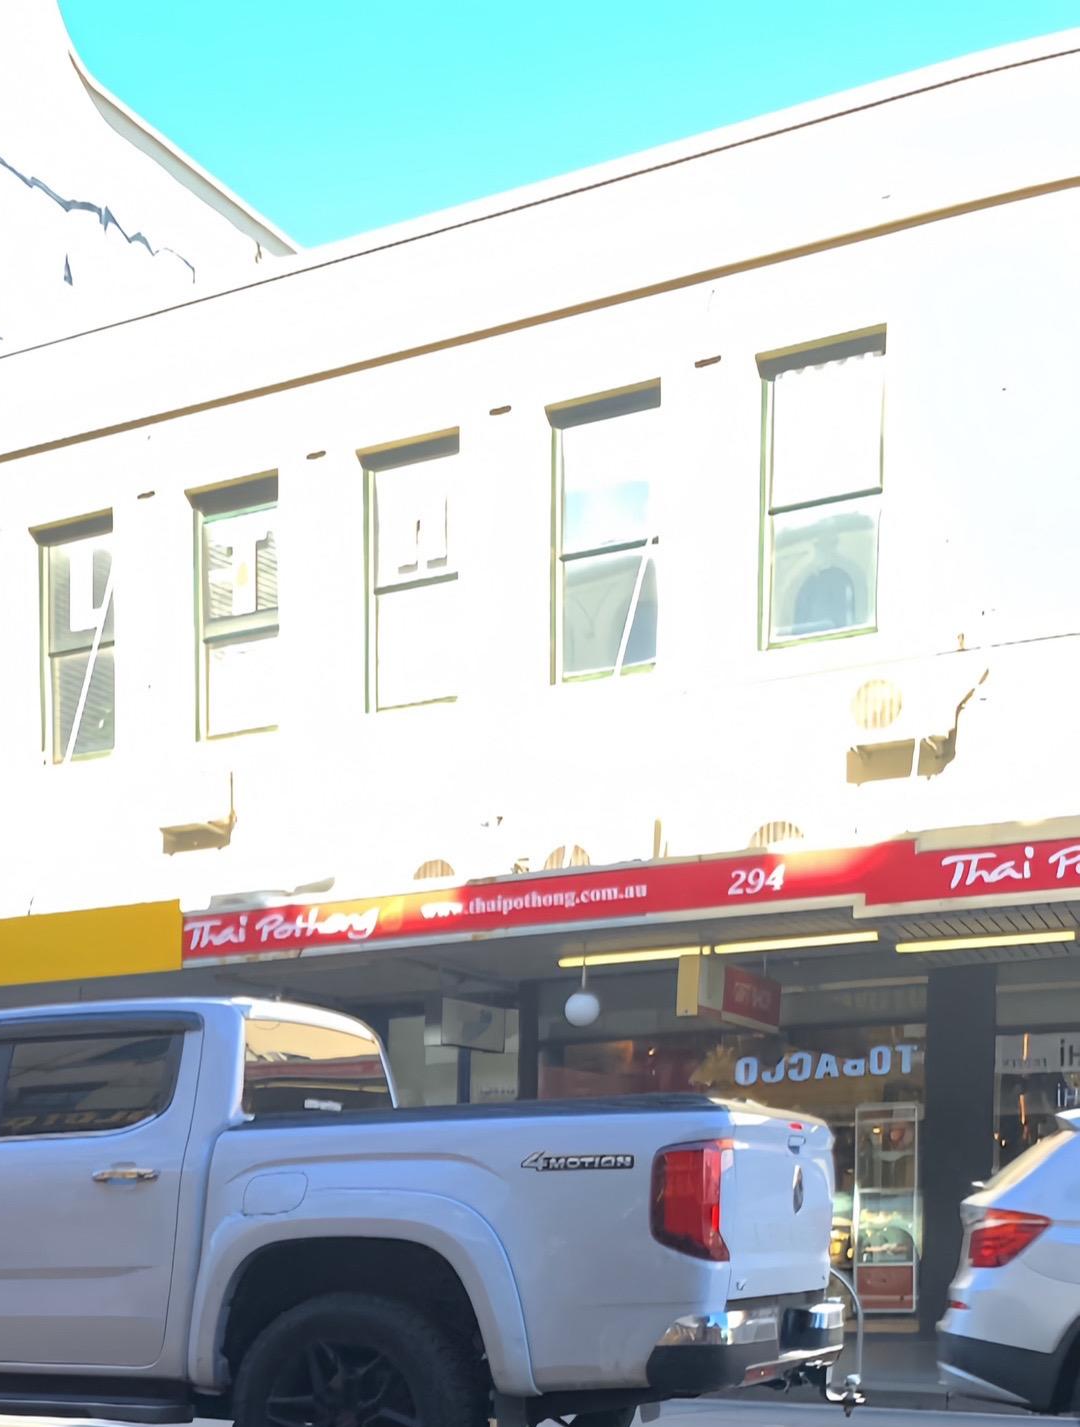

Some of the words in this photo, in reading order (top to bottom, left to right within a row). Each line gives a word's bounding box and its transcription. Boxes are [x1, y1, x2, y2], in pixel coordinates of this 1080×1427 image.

[728, 864, 786, 895] 294
[942, 846, 1034, 889] Thai
[420, 884, 647, 919] www.thaipothong.com.au
[184, 915, 248, 949] Thai
[255, 908, 380, 940] Pothong
[521, 1151, 632, 1172] 4MOTION
